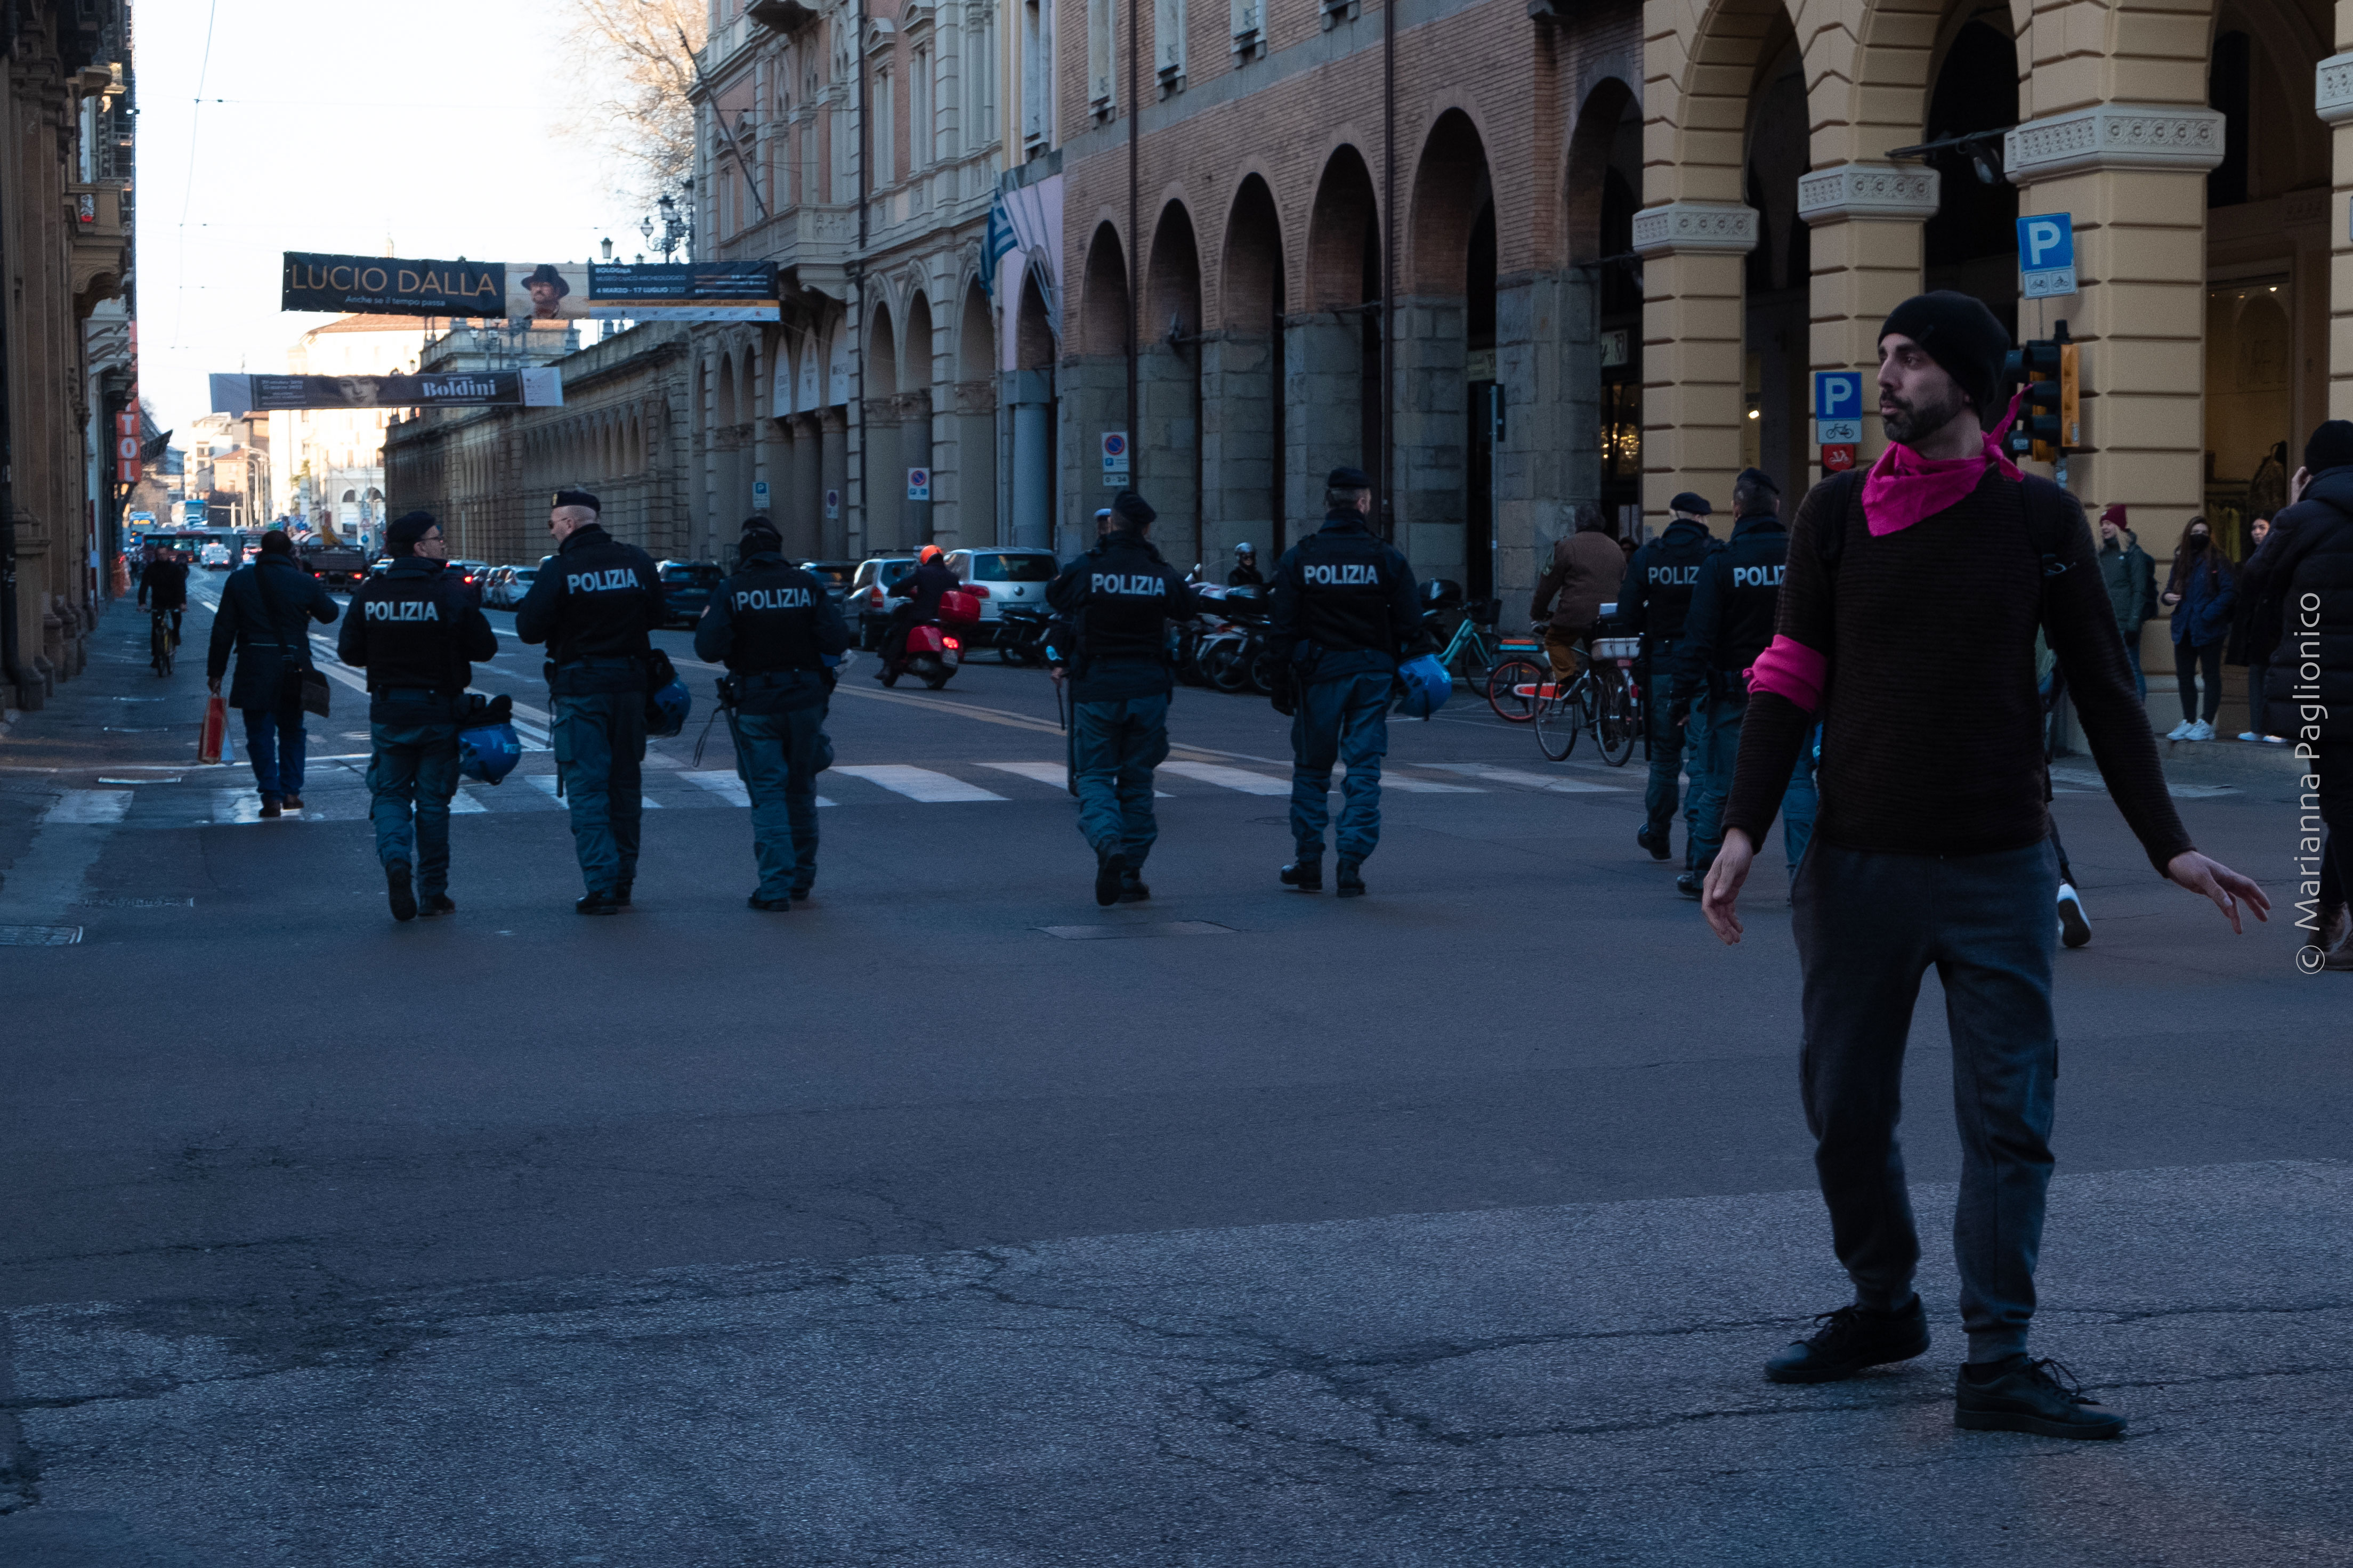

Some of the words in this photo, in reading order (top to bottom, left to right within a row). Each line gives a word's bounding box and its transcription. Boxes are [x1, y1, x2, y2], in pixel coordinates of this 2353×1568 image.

[2028, 221, 2061, 265] P
[293, 265, 388, 292] LUCIO
[398, 269, 497, 296] DALLA
[345, 295, 372, 304] Anche
[392, 298, 421, 306] tempo
[422, 379, 496, 397] Boldini
[1825, 377, 1853, 415] P
[567, 568, 639, 594] POLIZIA
[1091, 573, 1166, 596] POLIZIA
[1304, 564, 1378, 584] POLIZIA
[1648, 566, 1700, 584] POLIZ
[1733, 565, 1786, 587] POLIZ
[737, 588, 811, 611] POLIZIA
[365, 601, 439, 621] POLIZIA
